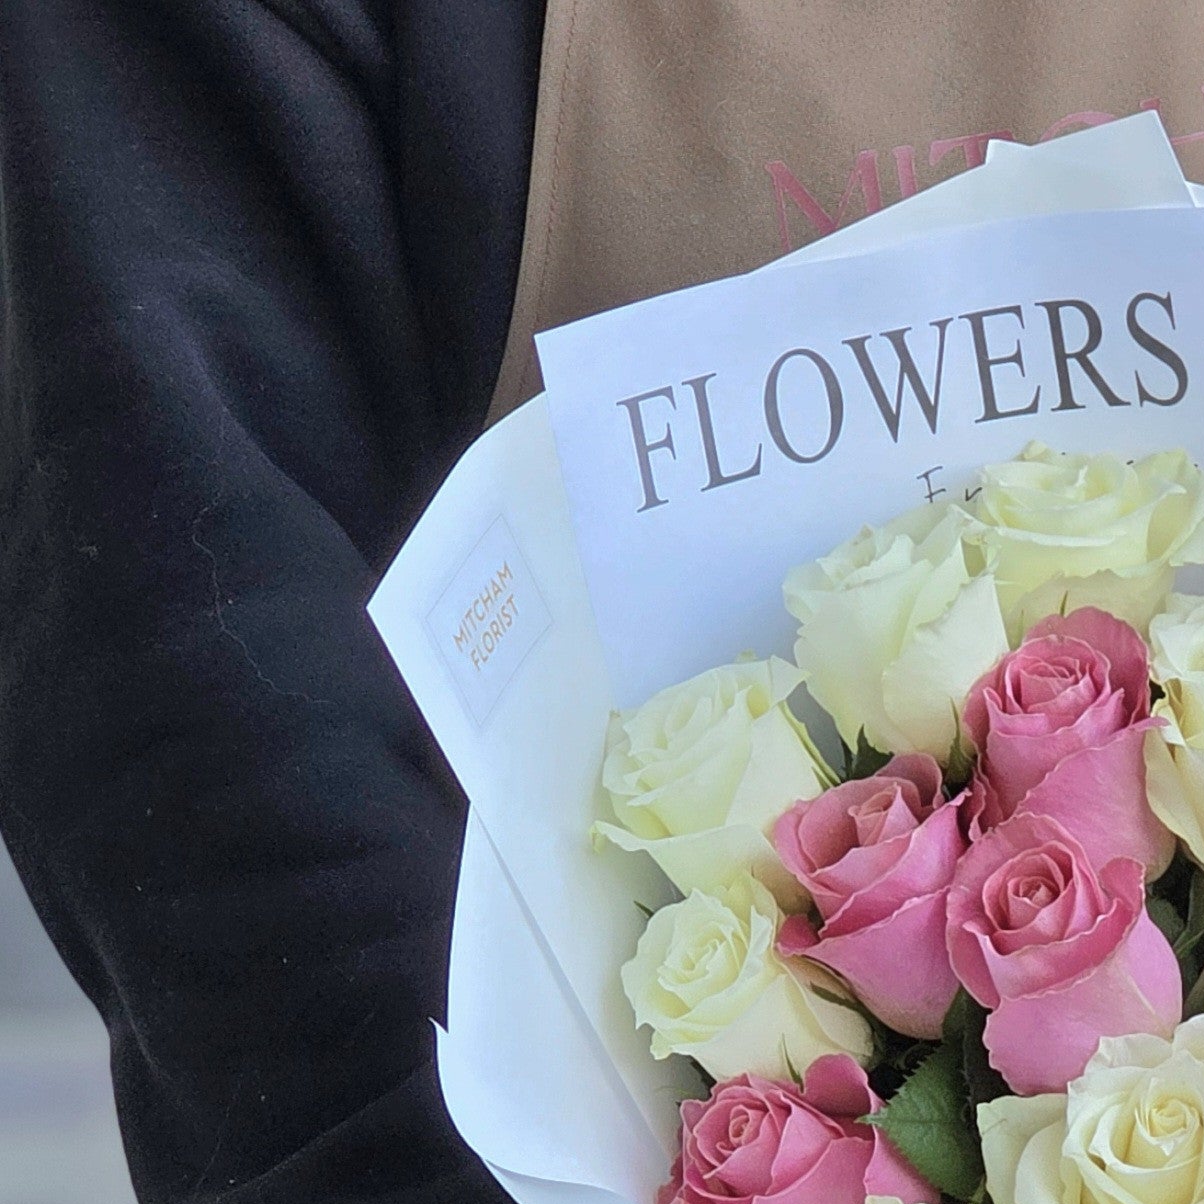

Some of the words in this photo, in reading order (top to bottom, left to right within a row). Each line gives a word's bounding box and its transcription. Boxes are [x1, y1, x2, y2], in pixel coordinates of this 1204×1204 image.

[616, 291, 1189, 513] FLOWERS
[452, 560, 515, 653] MITCHAM
[469, 594, 520, 673] FLORIST
